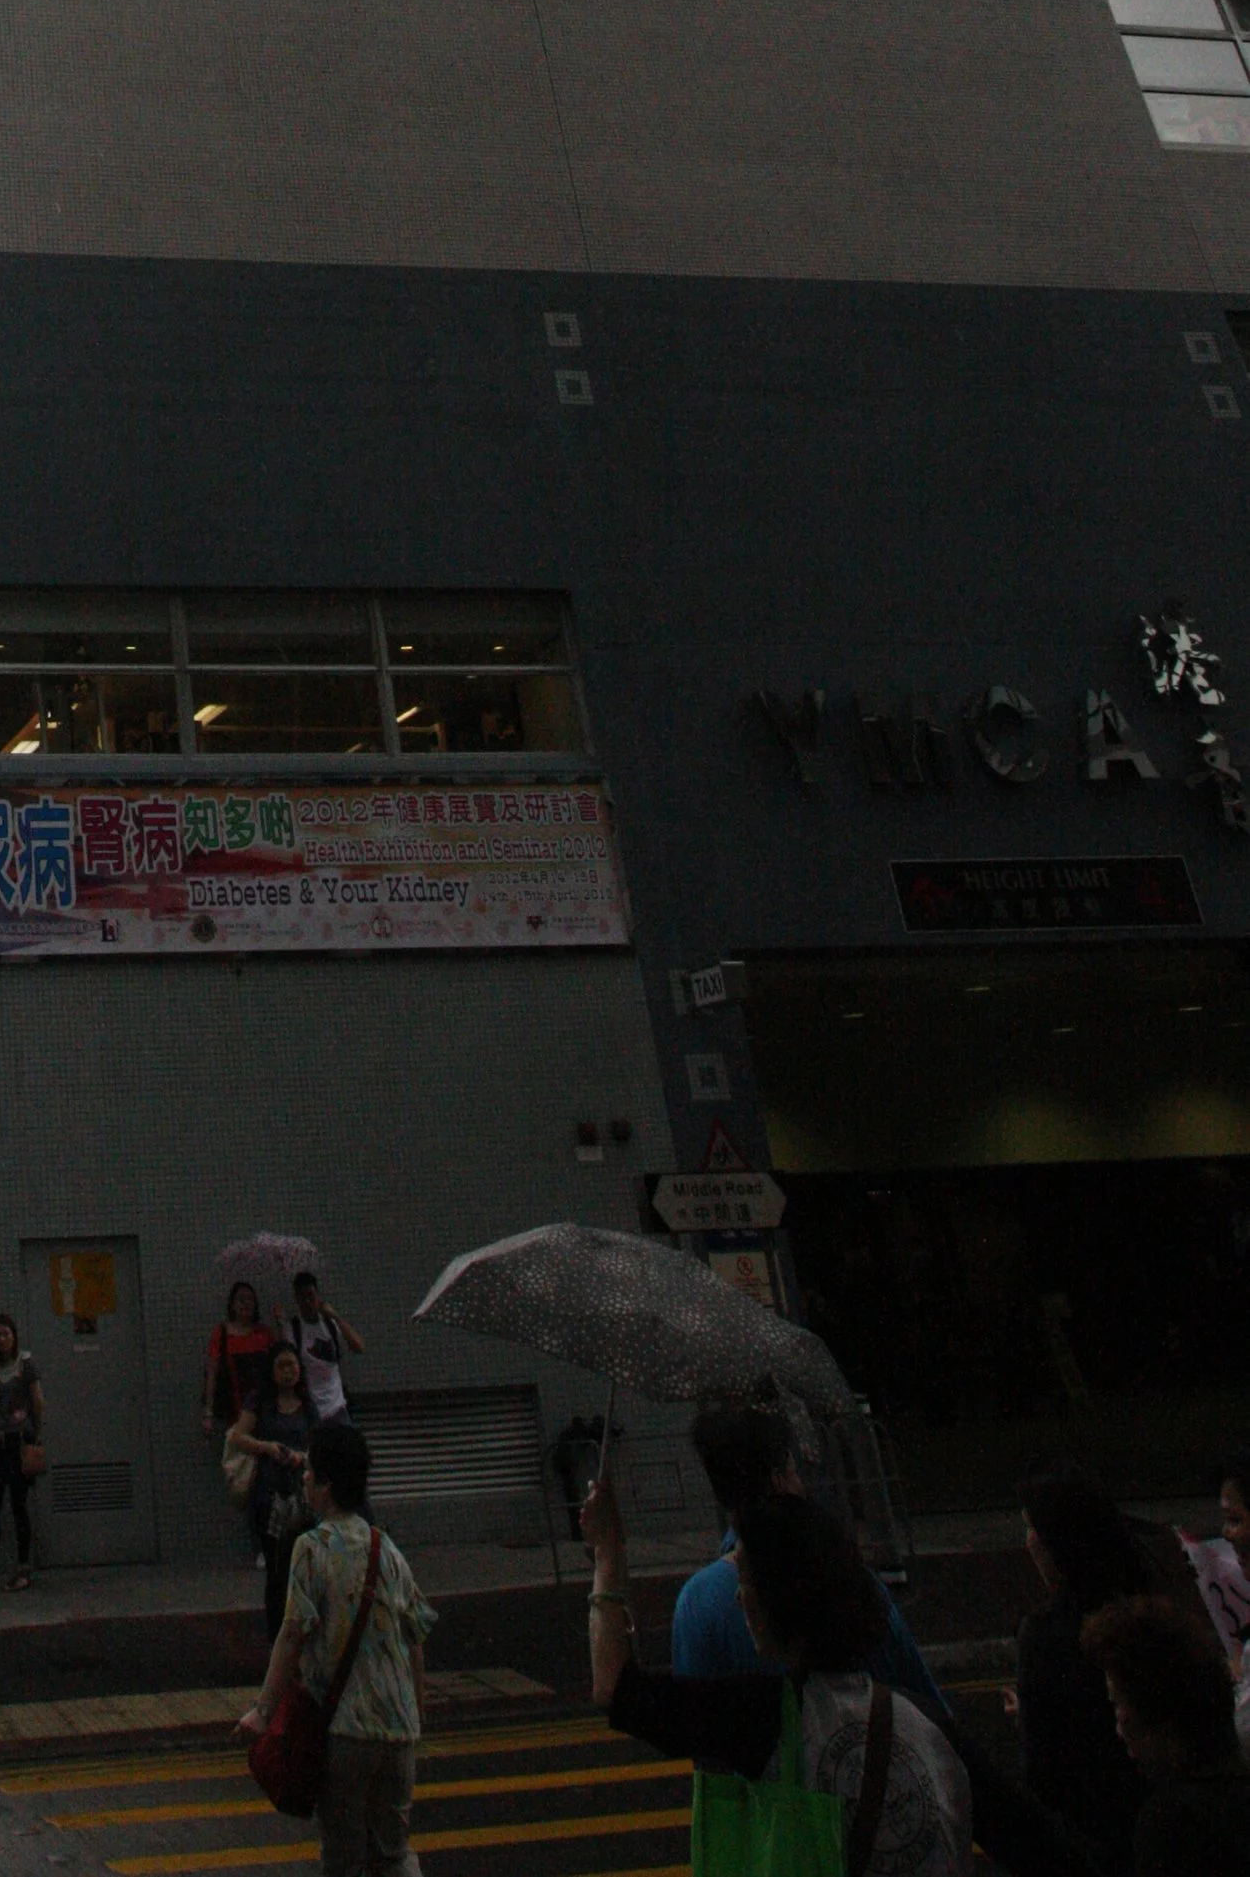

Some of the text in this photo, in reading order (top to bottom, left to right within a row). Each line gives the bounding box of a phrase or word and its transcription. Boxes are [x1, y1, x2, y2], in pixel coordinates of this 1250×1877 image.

[747, 685, 1161, 786] YMCA
[304, 836, 608, 863] Health Exhibition and Seminar 2012
[189, 875, 469, 907] Diabetes & Your Kidney
[959, 867, 1111, 890] HEIGHT LIMIT
[694, 974, 724, 999] TAXI
[724, 1179, 764, 1196] Road
